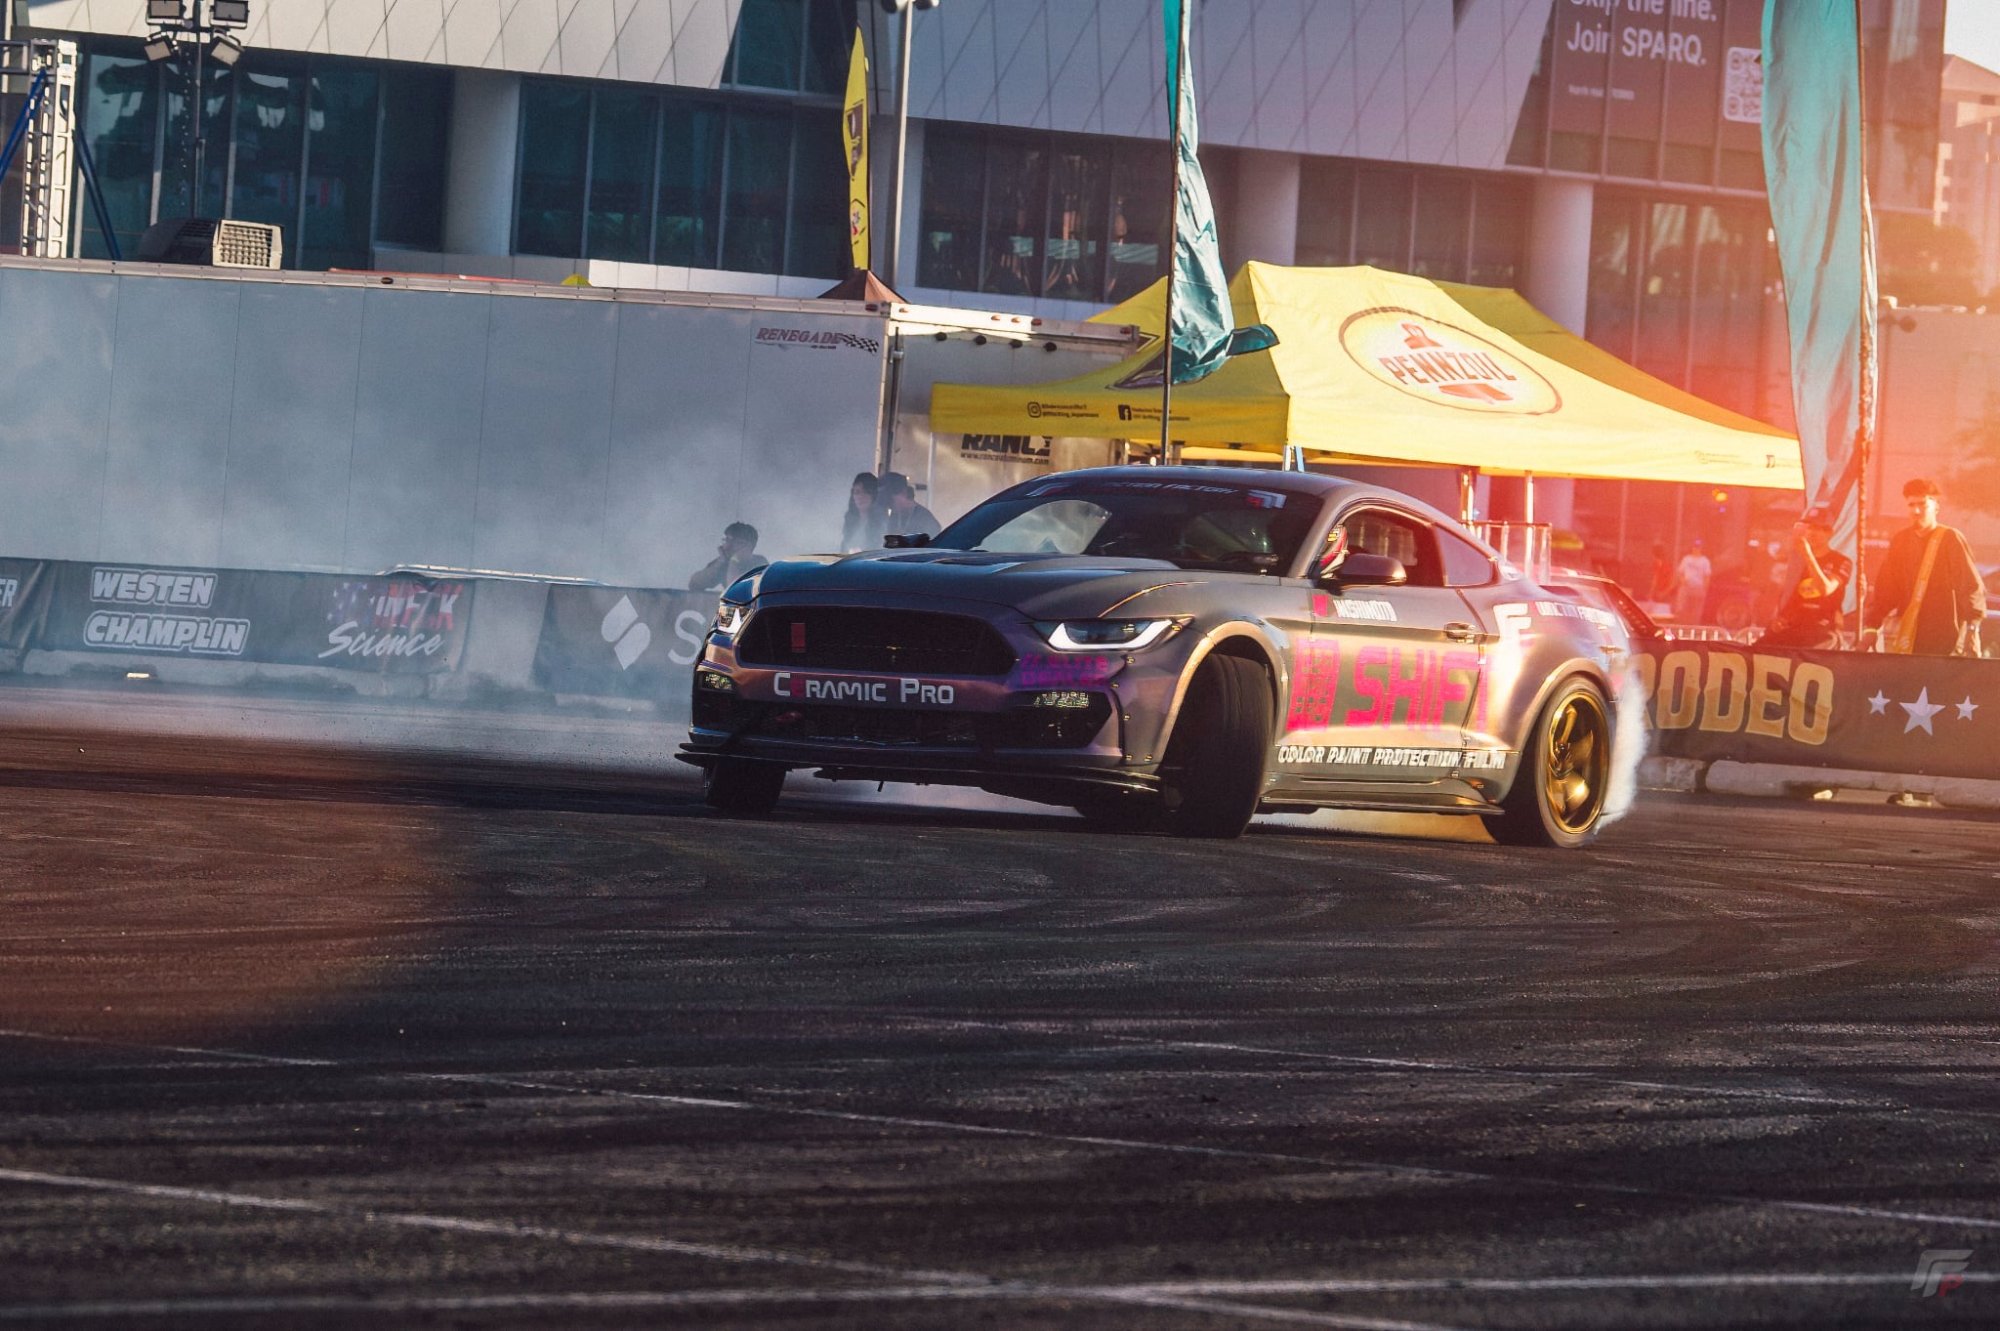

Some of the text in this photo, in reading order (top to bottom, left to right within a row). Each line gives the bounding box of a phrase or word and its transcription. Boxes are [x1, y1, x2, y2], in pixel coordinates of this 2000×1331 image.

[1622, 27, 1707, 66] SPARQ.
[756, 327, 842, 345] RENEGADE
[1378, 351, 1517, 385] PENNZOIL
[92, 570, 215, 606] WESTEN
[86, 614, 248, 651] CHAMPLIN
[318, 621, 445, 658] Science
